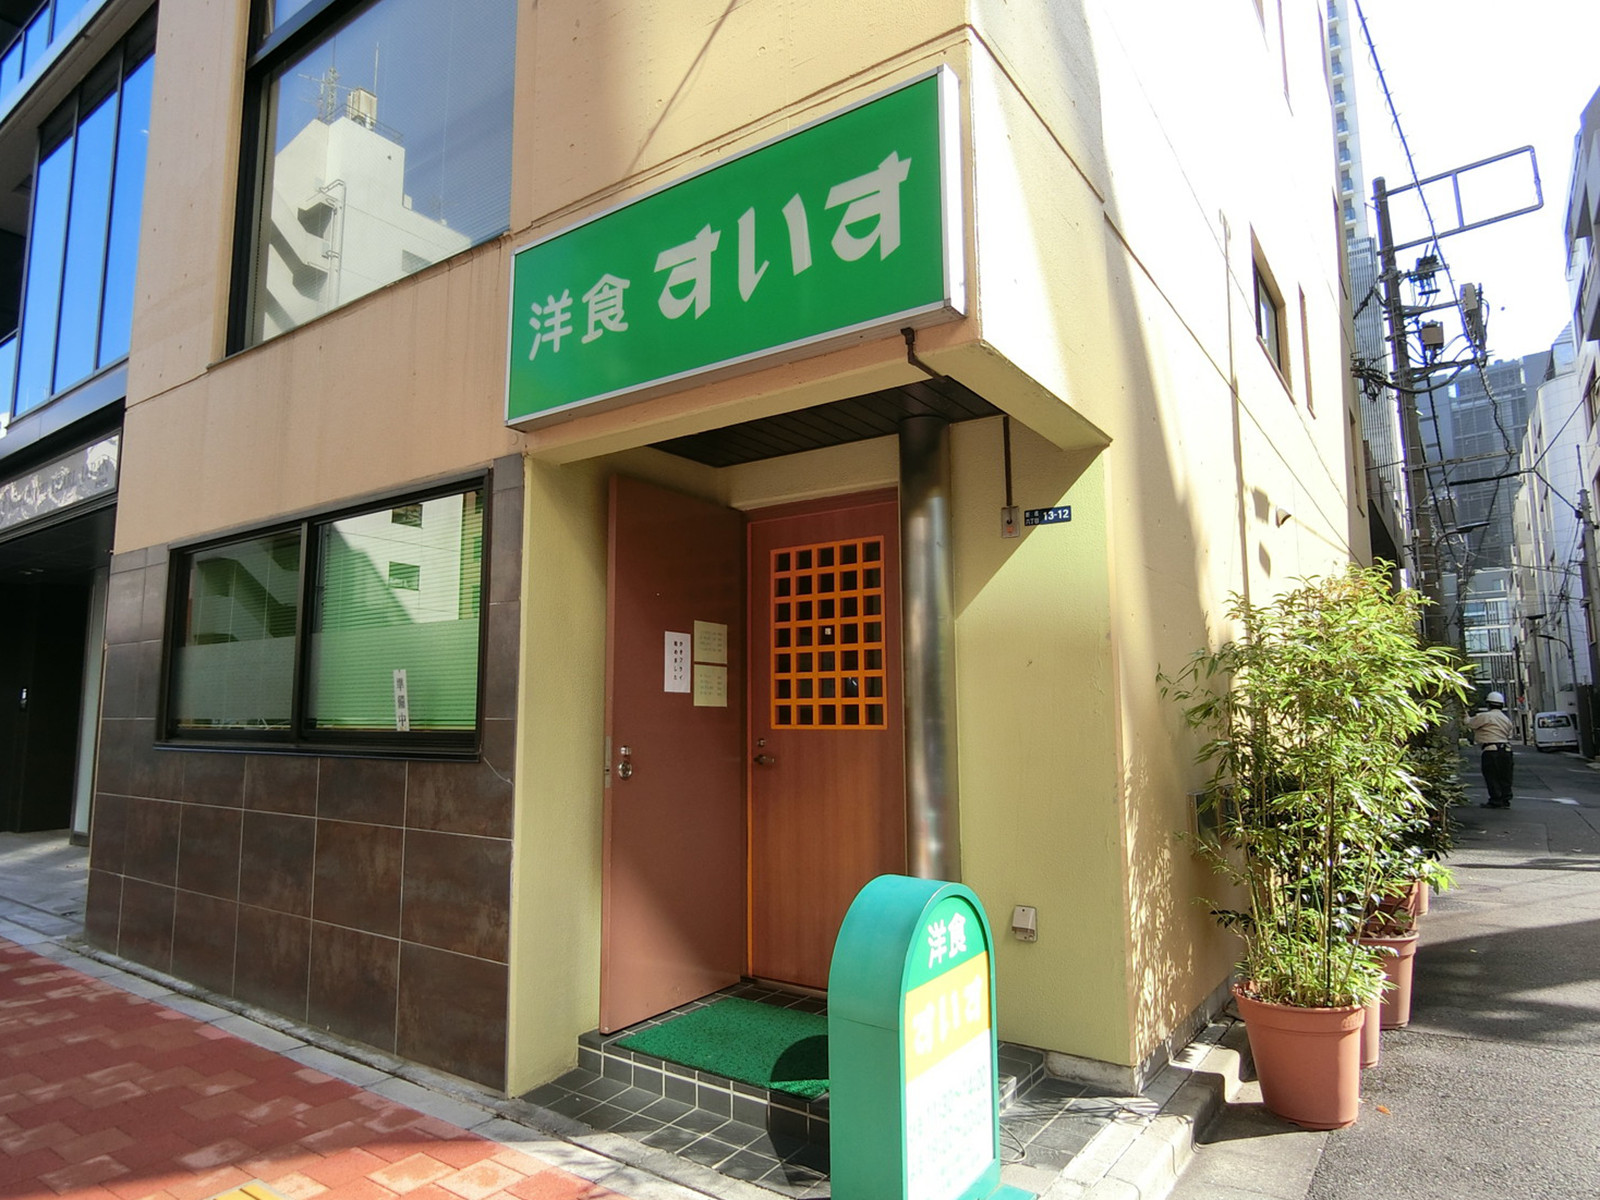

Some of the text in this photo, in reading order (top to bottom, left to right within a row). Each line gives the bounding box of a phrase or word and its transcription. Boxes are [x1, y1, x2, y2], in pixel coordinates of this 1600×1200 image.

[529, 150, 912, 361] 洋食 すいす
[1043, 509, 1069, 521] 13-12
[395, 677, 407, 727] 準備中
[927, 912, 967, 969] 洋食
[912, 974, 984, 1055] すいす
